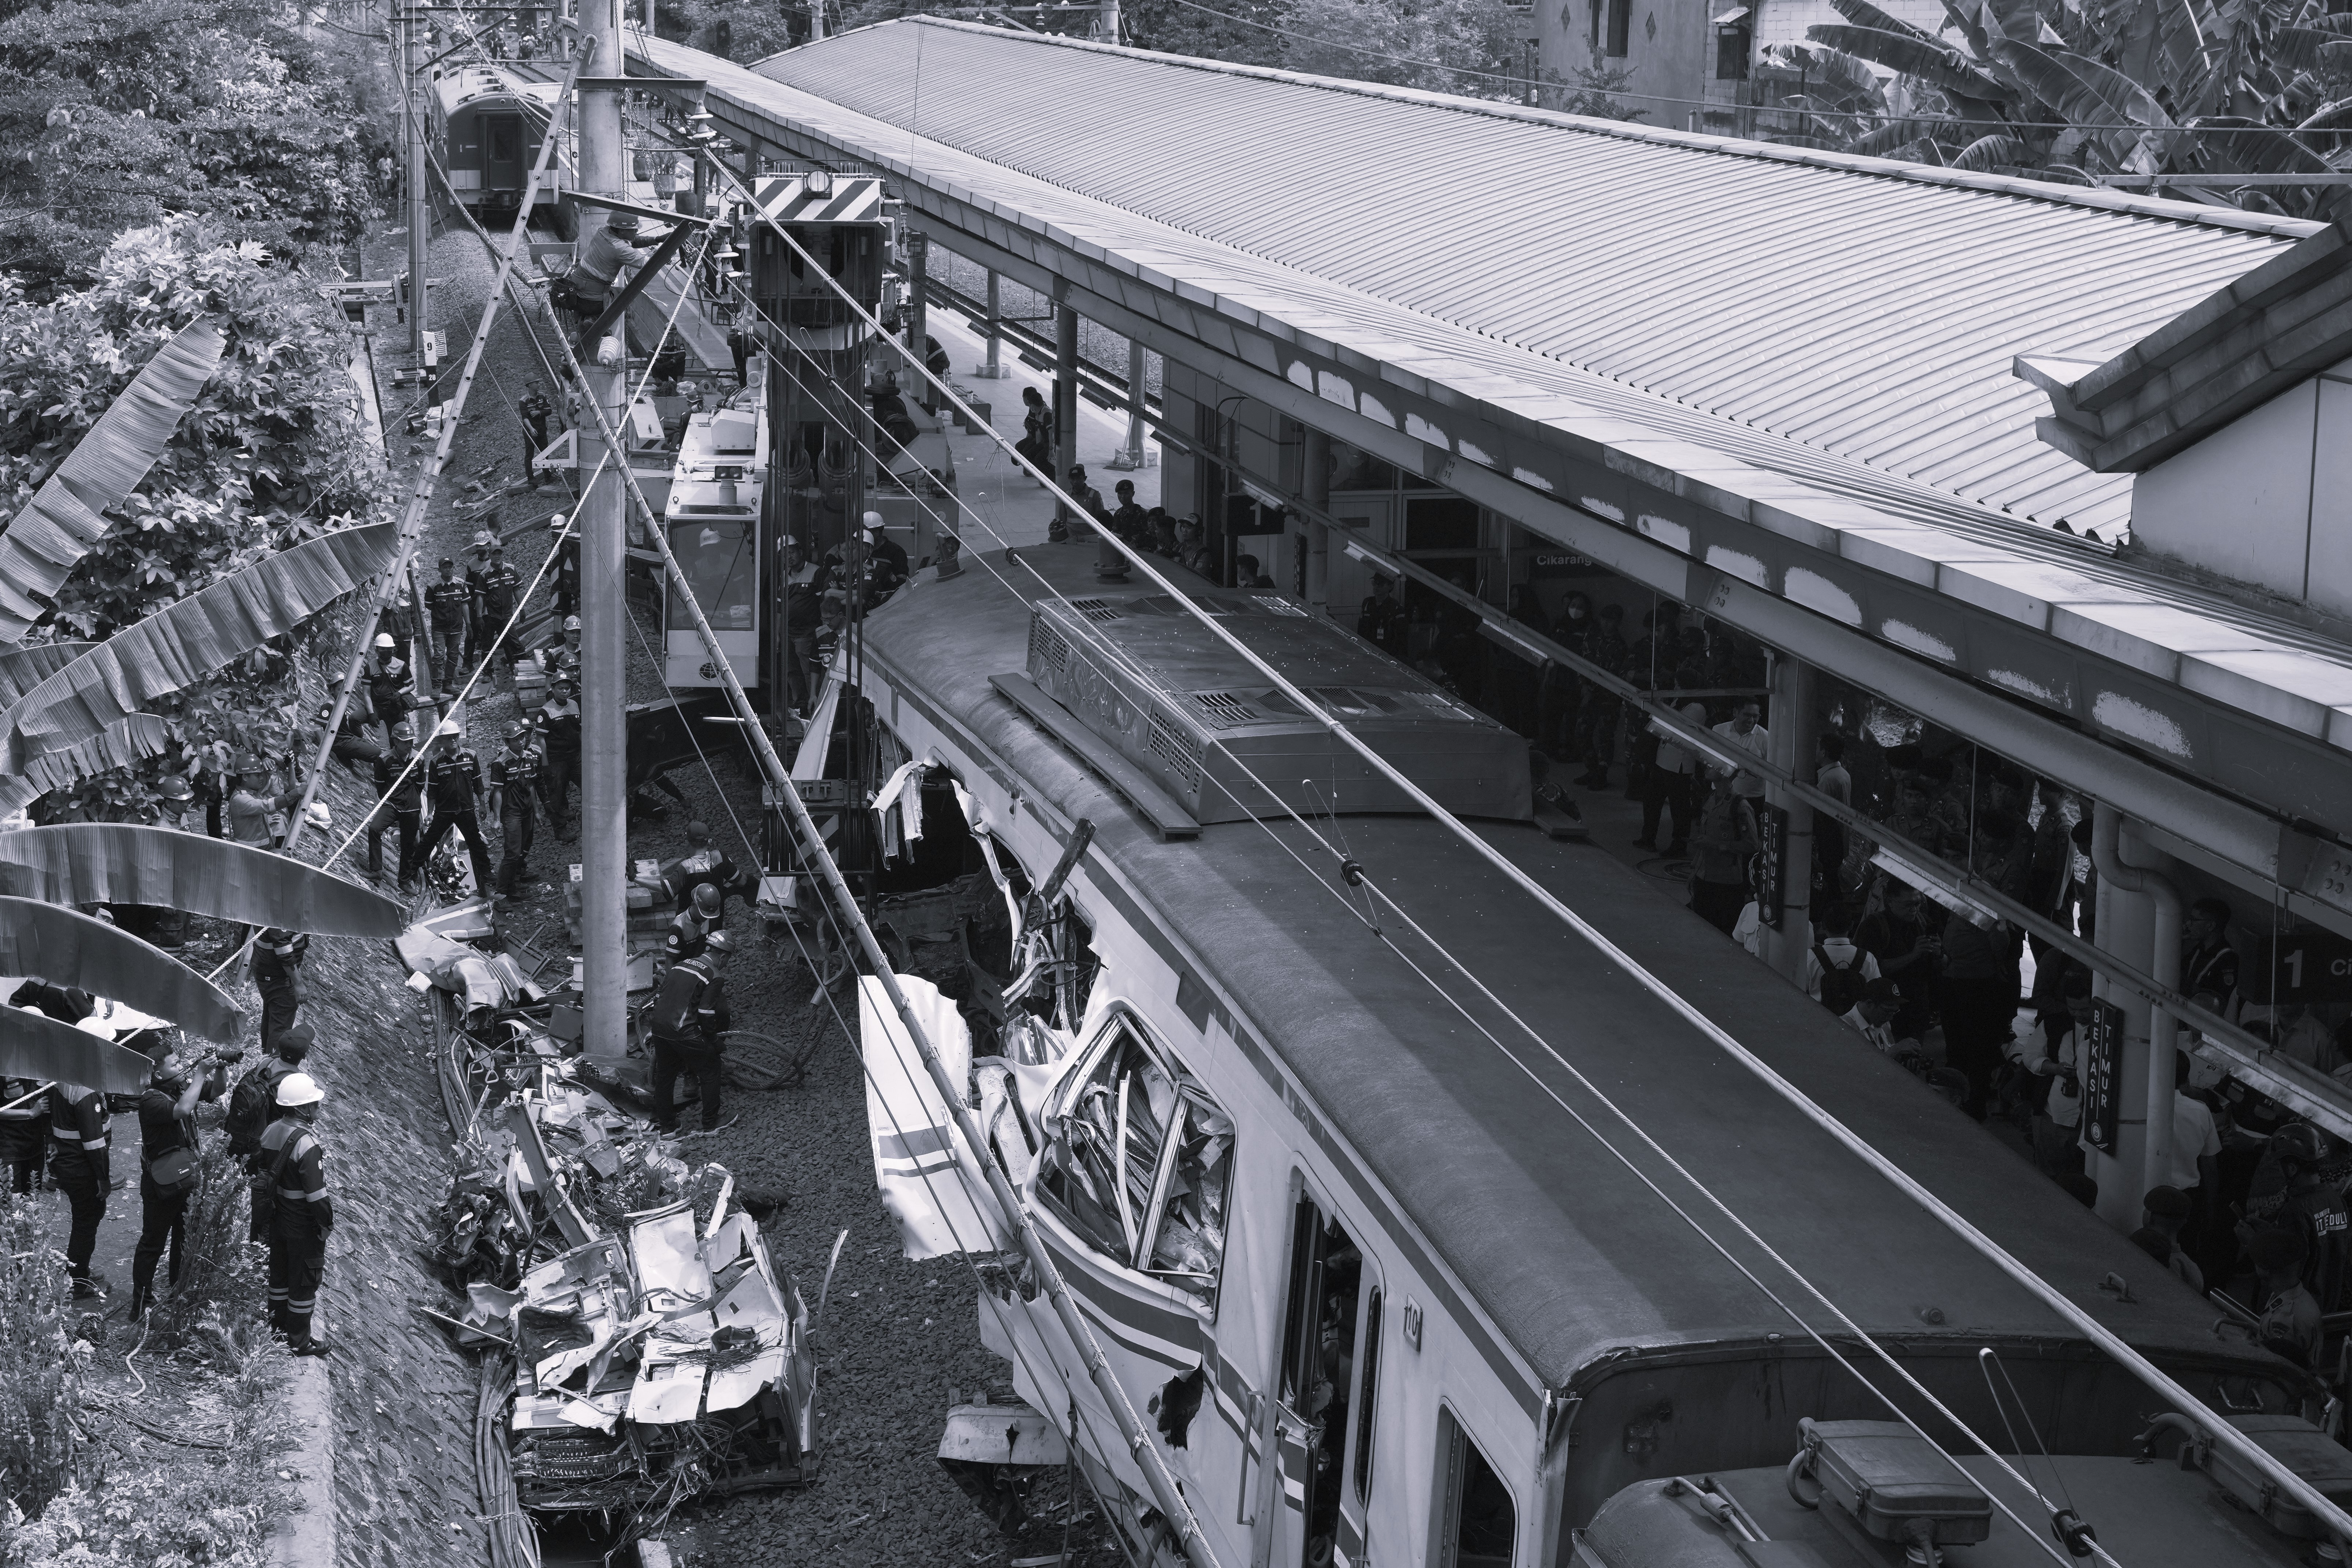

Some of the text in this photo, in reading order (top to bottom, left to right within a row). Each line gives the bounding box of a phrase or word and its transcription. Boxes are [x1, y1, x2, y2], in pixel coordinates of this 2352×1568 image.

[427, 342, 432, 351] 9
[1250, 501, 1261, 525] 1
[1537, 555, 1592, 566] Cikarang
[2284, 949, 2303, 988] 1
[2090, 1010, 2100, 1108] BEKASI
[2101, 1024, 2111, 1108] TIMUR
[1408, 1303, 1417, 1336] 10
